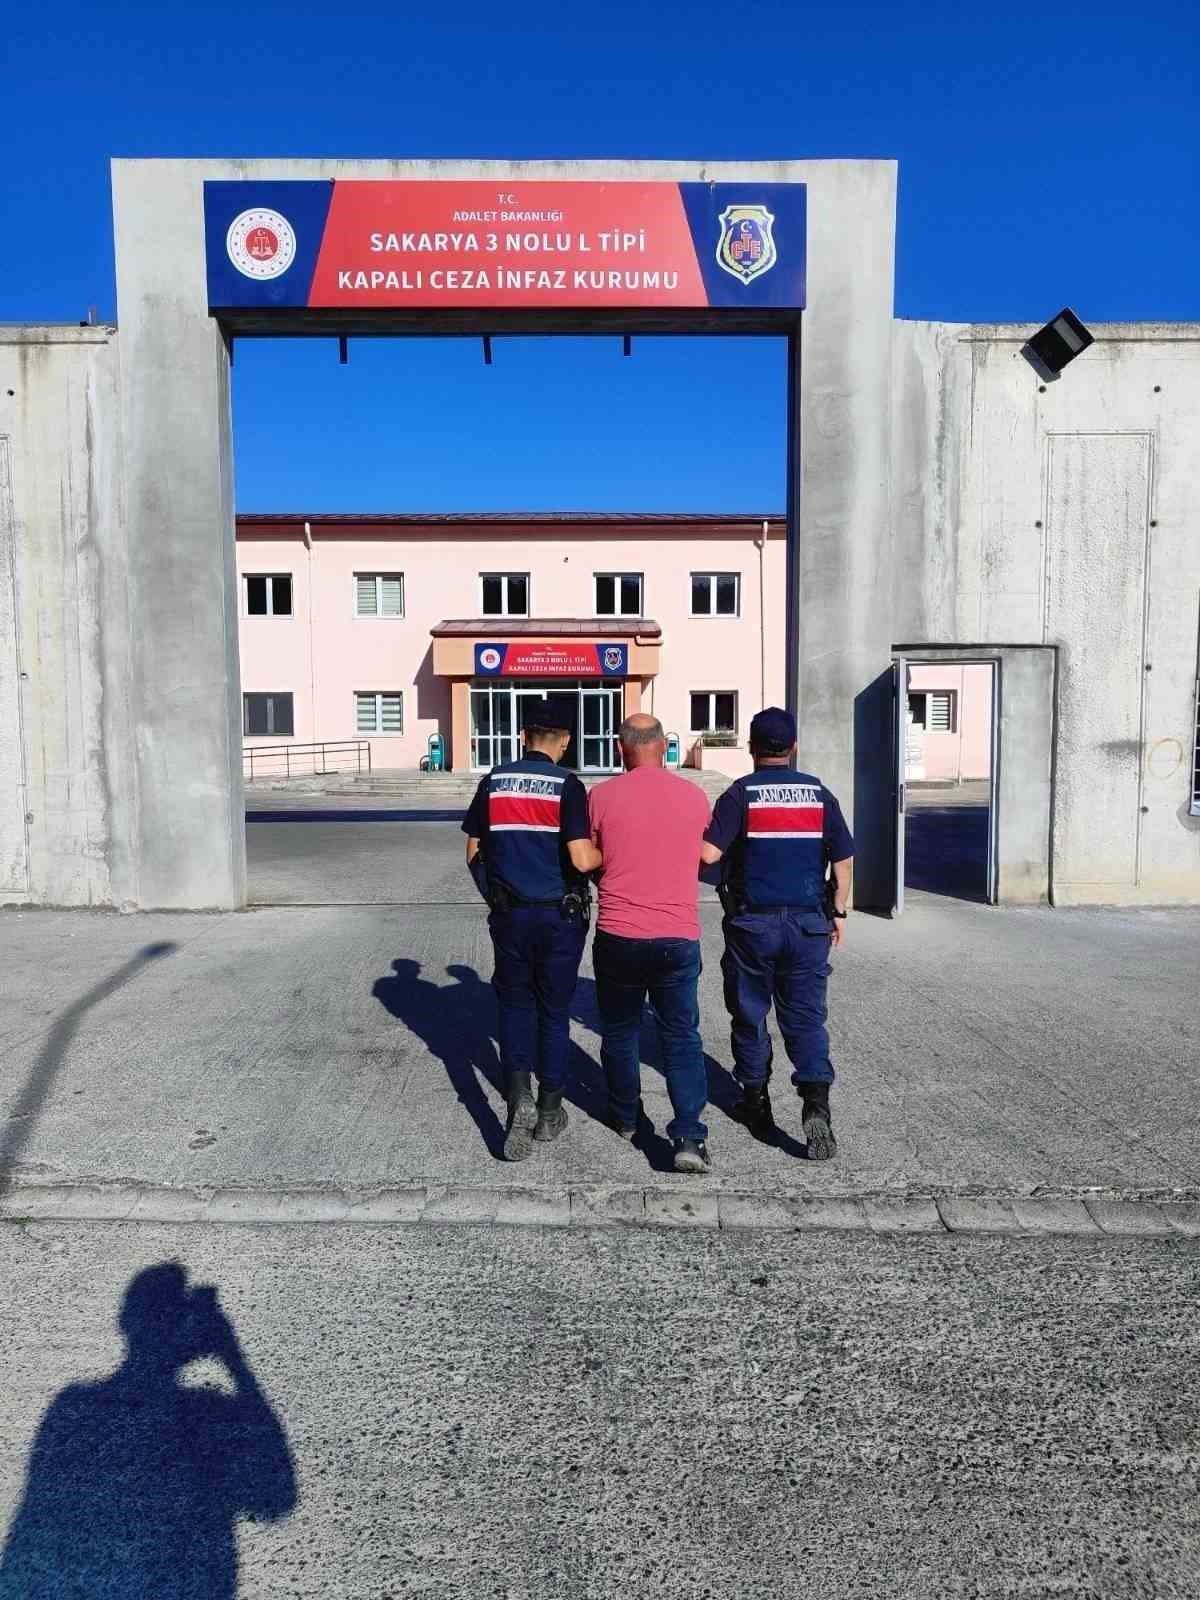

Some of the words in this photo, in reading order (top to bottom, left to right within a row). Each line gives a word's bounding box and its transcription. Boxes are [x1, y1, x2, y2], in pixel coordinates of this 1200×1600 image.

[453, 211, 497, 222] ADALET
[500, 209, 563, 222] BAKANLIĞI
[370, 233, 479, 251] SAKARYA
[485, 233, 498, 251] 3
[506, 233, 571, 251] NOLU
[579, 233, 592, 251] L
[597, 229, 646, 252] TİPİ
[338, 271, 422, 289] KAPALI
[430, 271, 490, 289] CEZA
[497, 266, 566, 289] İNFAZ
[573, 271, 678, 290] KURUMU
[757, 789, 817, 803] JANDARMA
